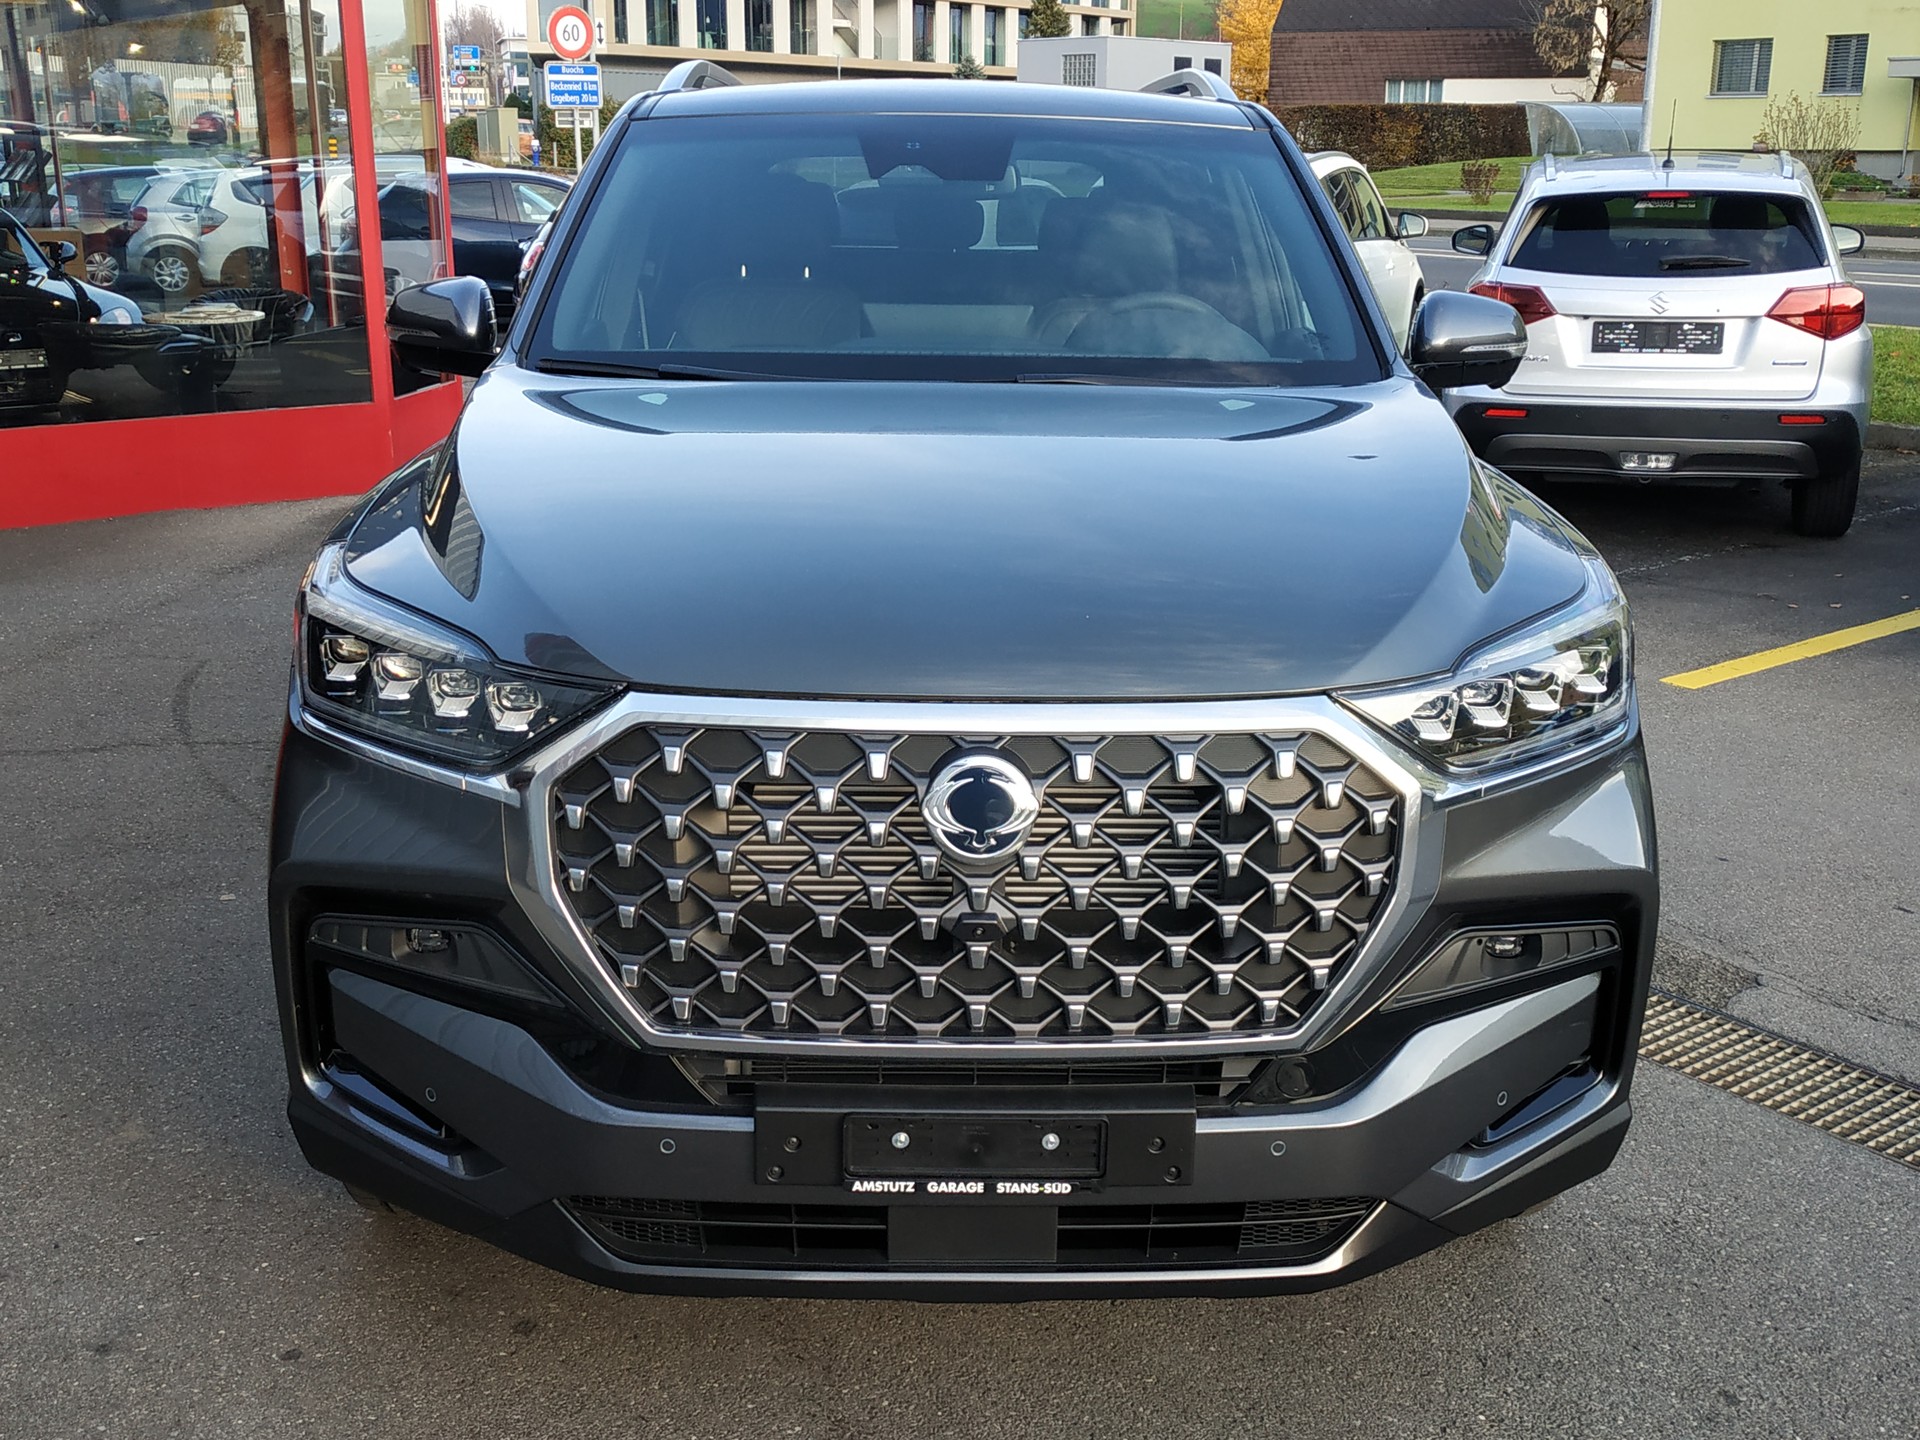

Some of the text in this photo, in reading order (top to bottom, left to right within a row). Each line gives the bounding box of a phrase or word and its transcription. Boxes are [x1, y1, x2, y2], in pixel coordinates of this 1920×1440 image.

[562, 24, 580, 42] 60
[561, 66, 584, 74] Buochs
[550, 82, 597, 90] Beckenried 8 km
[551, 93, 598, 104] Engelberg 20 km
[851, 1181, 1072, 1194] AMSTUTZ GARAGE STANS-SÜD
